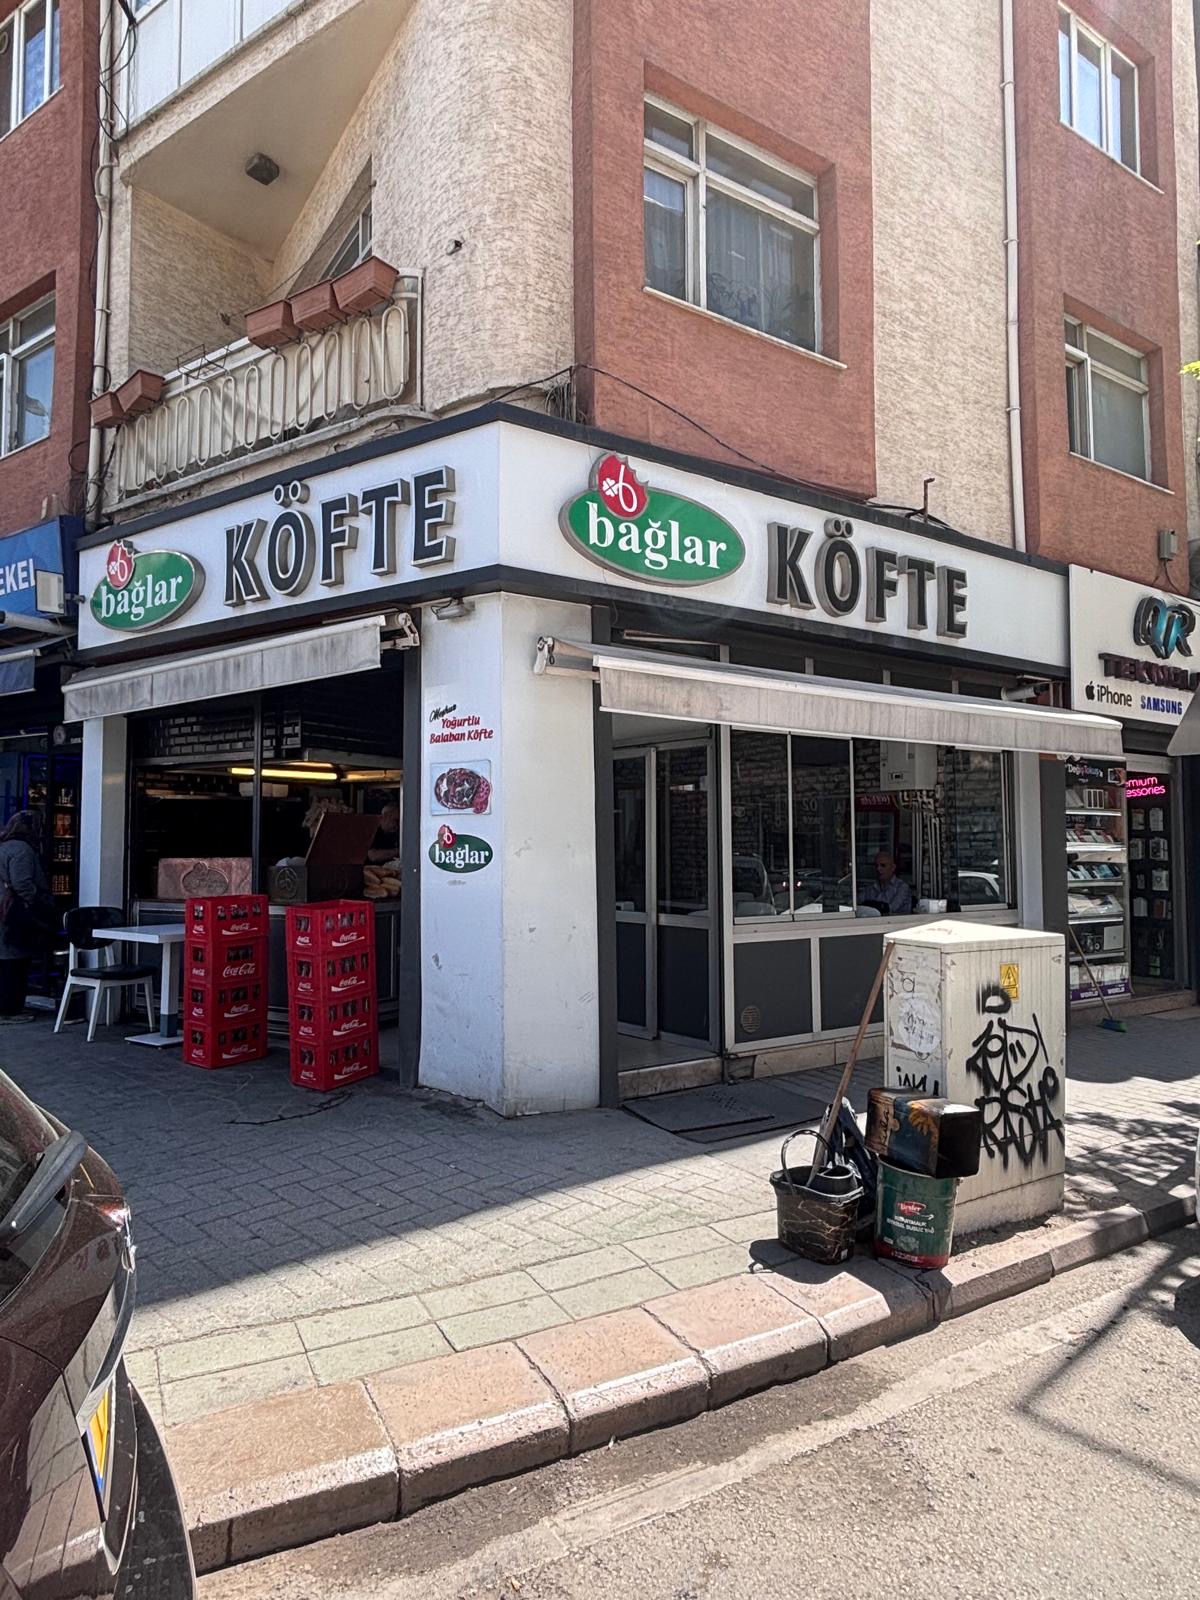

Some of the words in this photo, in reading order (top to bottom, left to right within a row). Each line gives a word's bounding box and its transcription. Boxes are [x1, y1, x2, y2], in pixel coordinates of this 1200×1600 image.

[224, 465, 456, 607] KÖFTE
[586, 500, 728, 571] bağlar
[766, 517, 968, 639] KÖFTE
[100, 574, 183, 621] bağlar
[1097, 684, 1133, 707] iPhone
[1140, 695, 1182, 715] SAMSUNG
[441, 715, 481, 729] Yoğurtlu
[429, 732, 466, 744] Balaban
[466, 728, 494, 742] Köfte
[434, 844, 490, 869] bağlar
